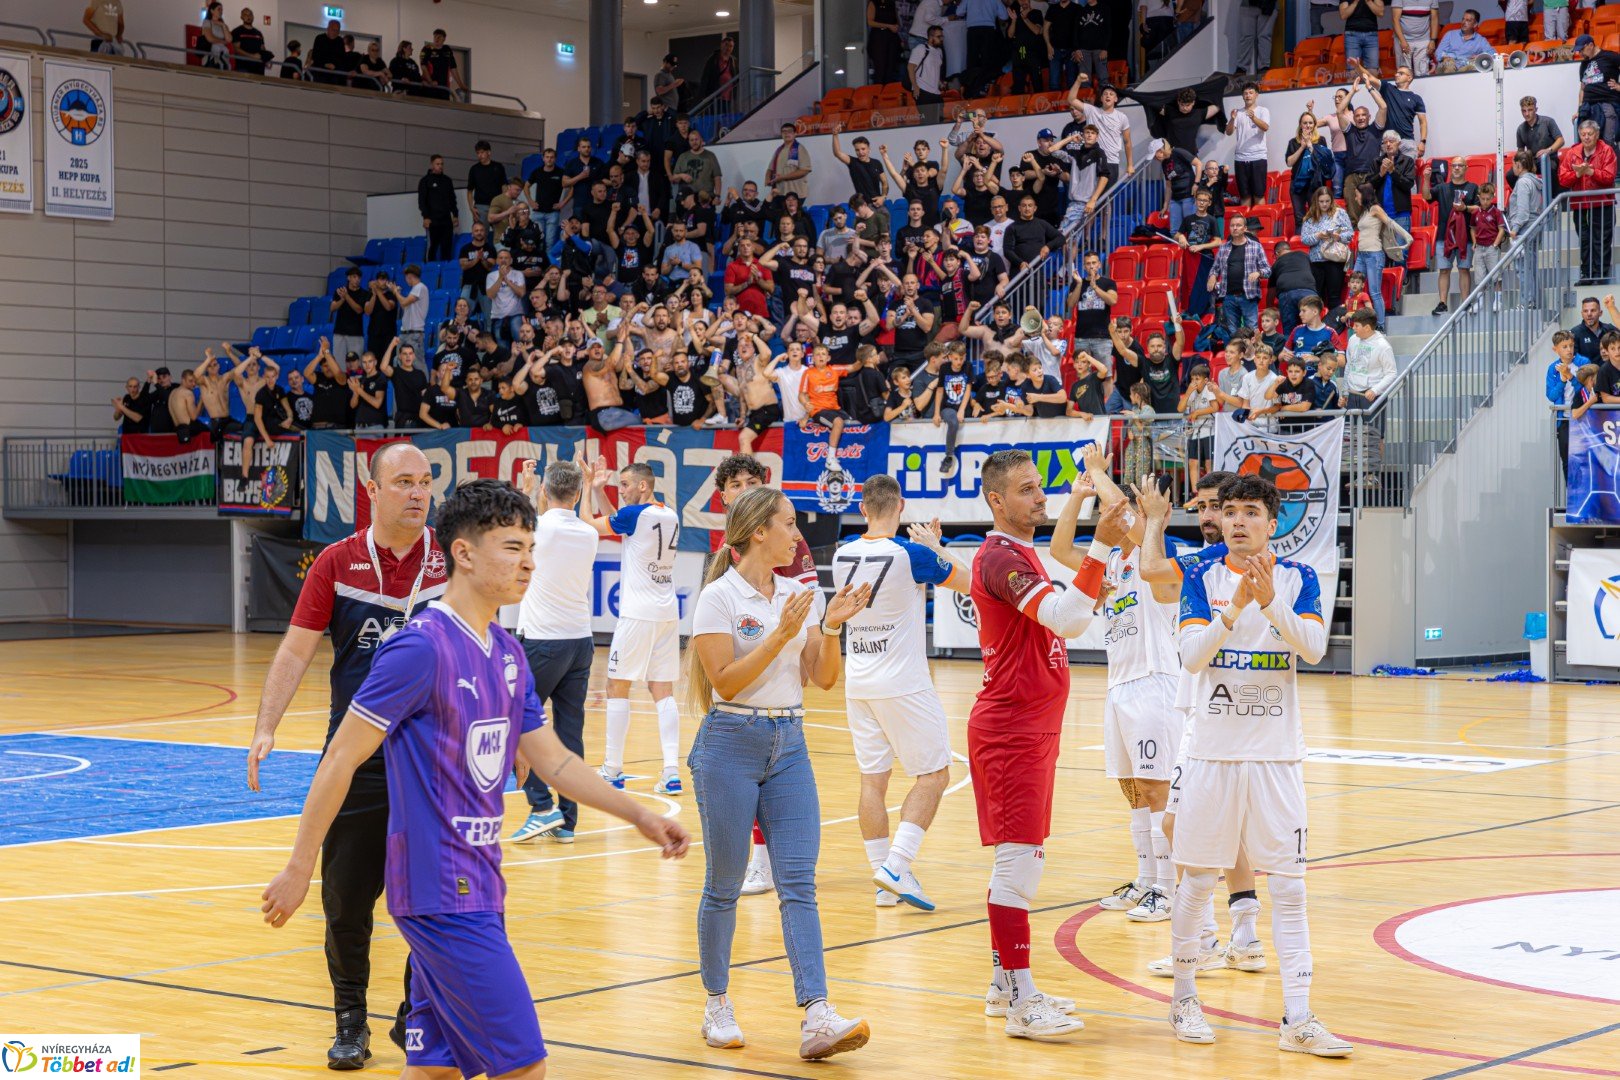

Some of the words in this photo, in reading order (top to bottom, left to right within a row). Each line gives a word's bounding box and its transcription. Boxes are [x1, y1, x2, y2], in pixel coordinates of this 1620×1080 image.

[70, 157, 88, 169] 2025
[58, 171, 78, 182] HEPP
[80, 173, 100, 183] KUPA
[63, 188, 107, 201] HELYEZÉS
[223, 441, 292, 467] EATERN
[1232, 440, 1315, 472] FUTSAL
[132, 456, 210, 478] NYÍREGYHÁZA
[652, 522, 680, 561] 14
[349, 562, 372, 571] JAKO
[836, 555, 895, 609] 77
[852, 638, 889, 654] BÁLINT
[1208, 703, 1283, 717] STUDIO
[1137, 739, 1157, 760] 10
